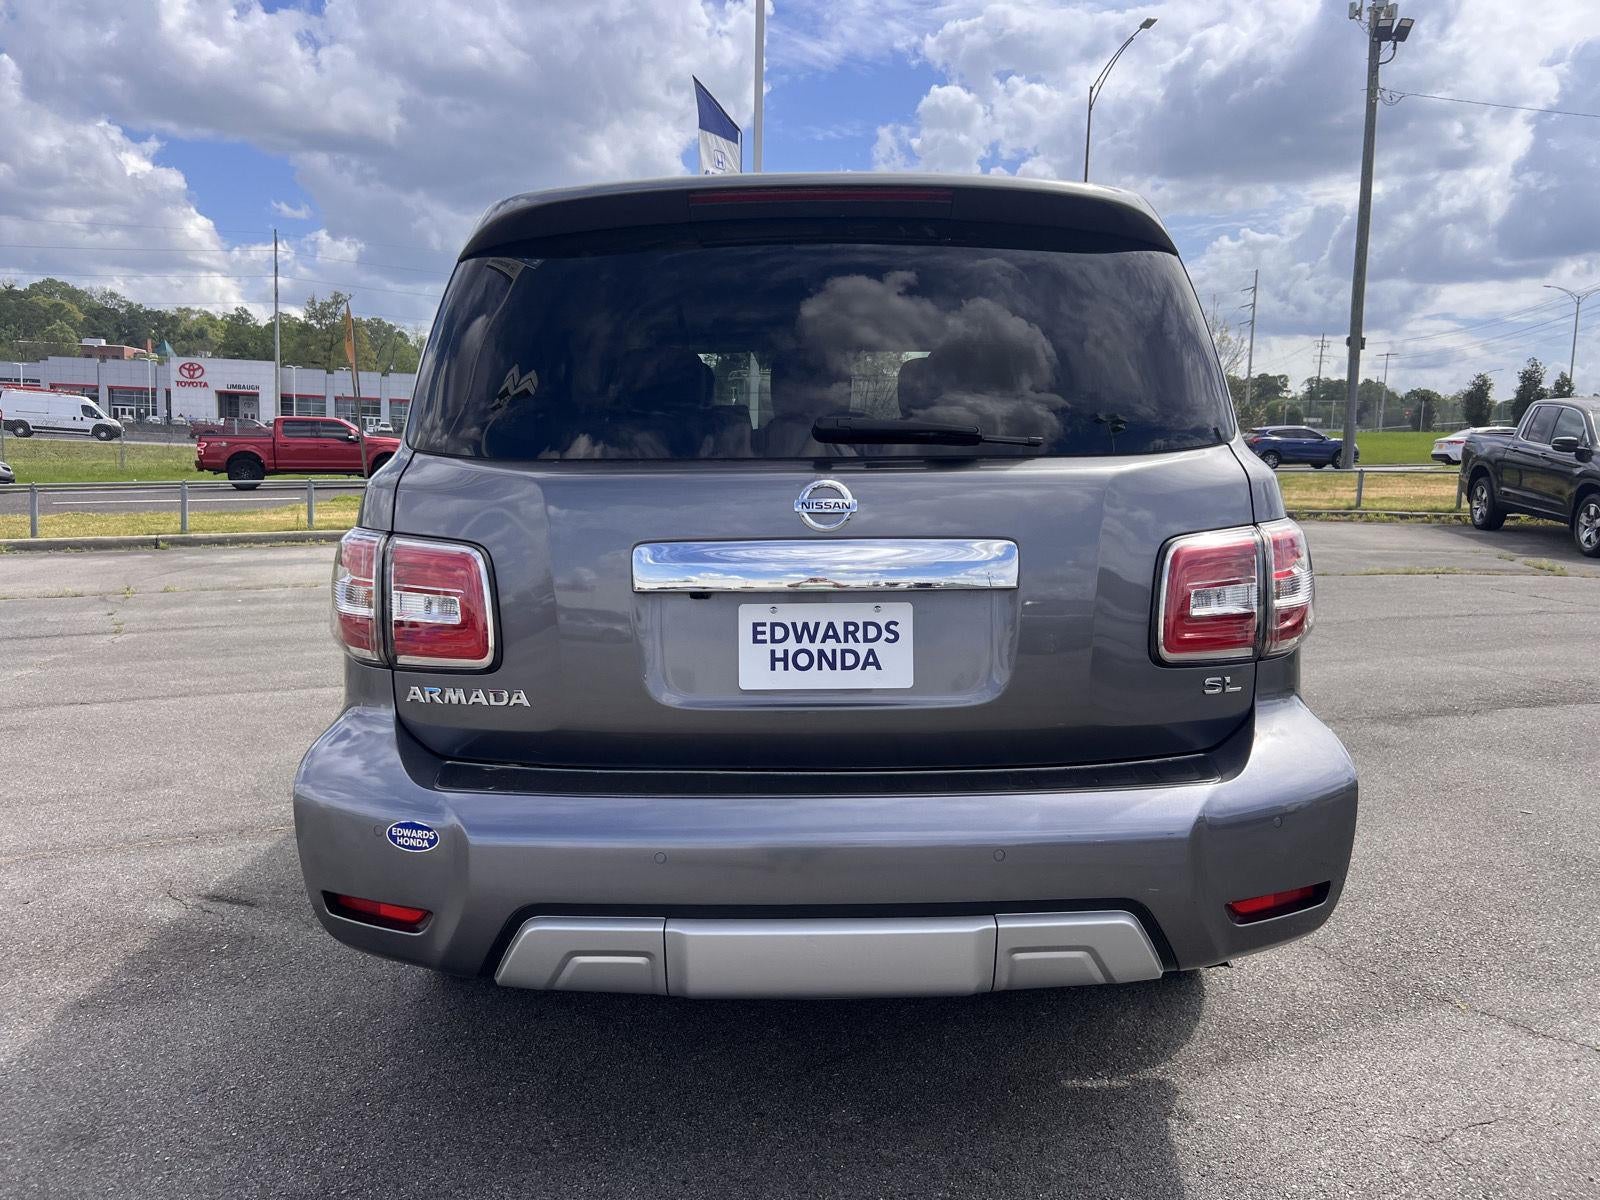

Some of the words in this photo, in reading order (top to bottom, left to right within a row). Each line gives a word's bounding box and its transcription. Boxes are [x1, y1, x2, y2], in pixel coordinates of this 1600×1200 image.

[175, 380, 209, 389] TOYOTA
[226, 383, 260, 391] LIMBAUGH
[801, 501, 851, 510] NISSAN
[752, 620, 900, 644] EDWARDS
[769, 648, 883, 672] HONDA
[1203, 676, 1242, 695] SL
[405, 686, 531, 707] ARMADA
[391, 827, 435, 840] EDWARDS
[396, 836, 429, 848] HONDA
